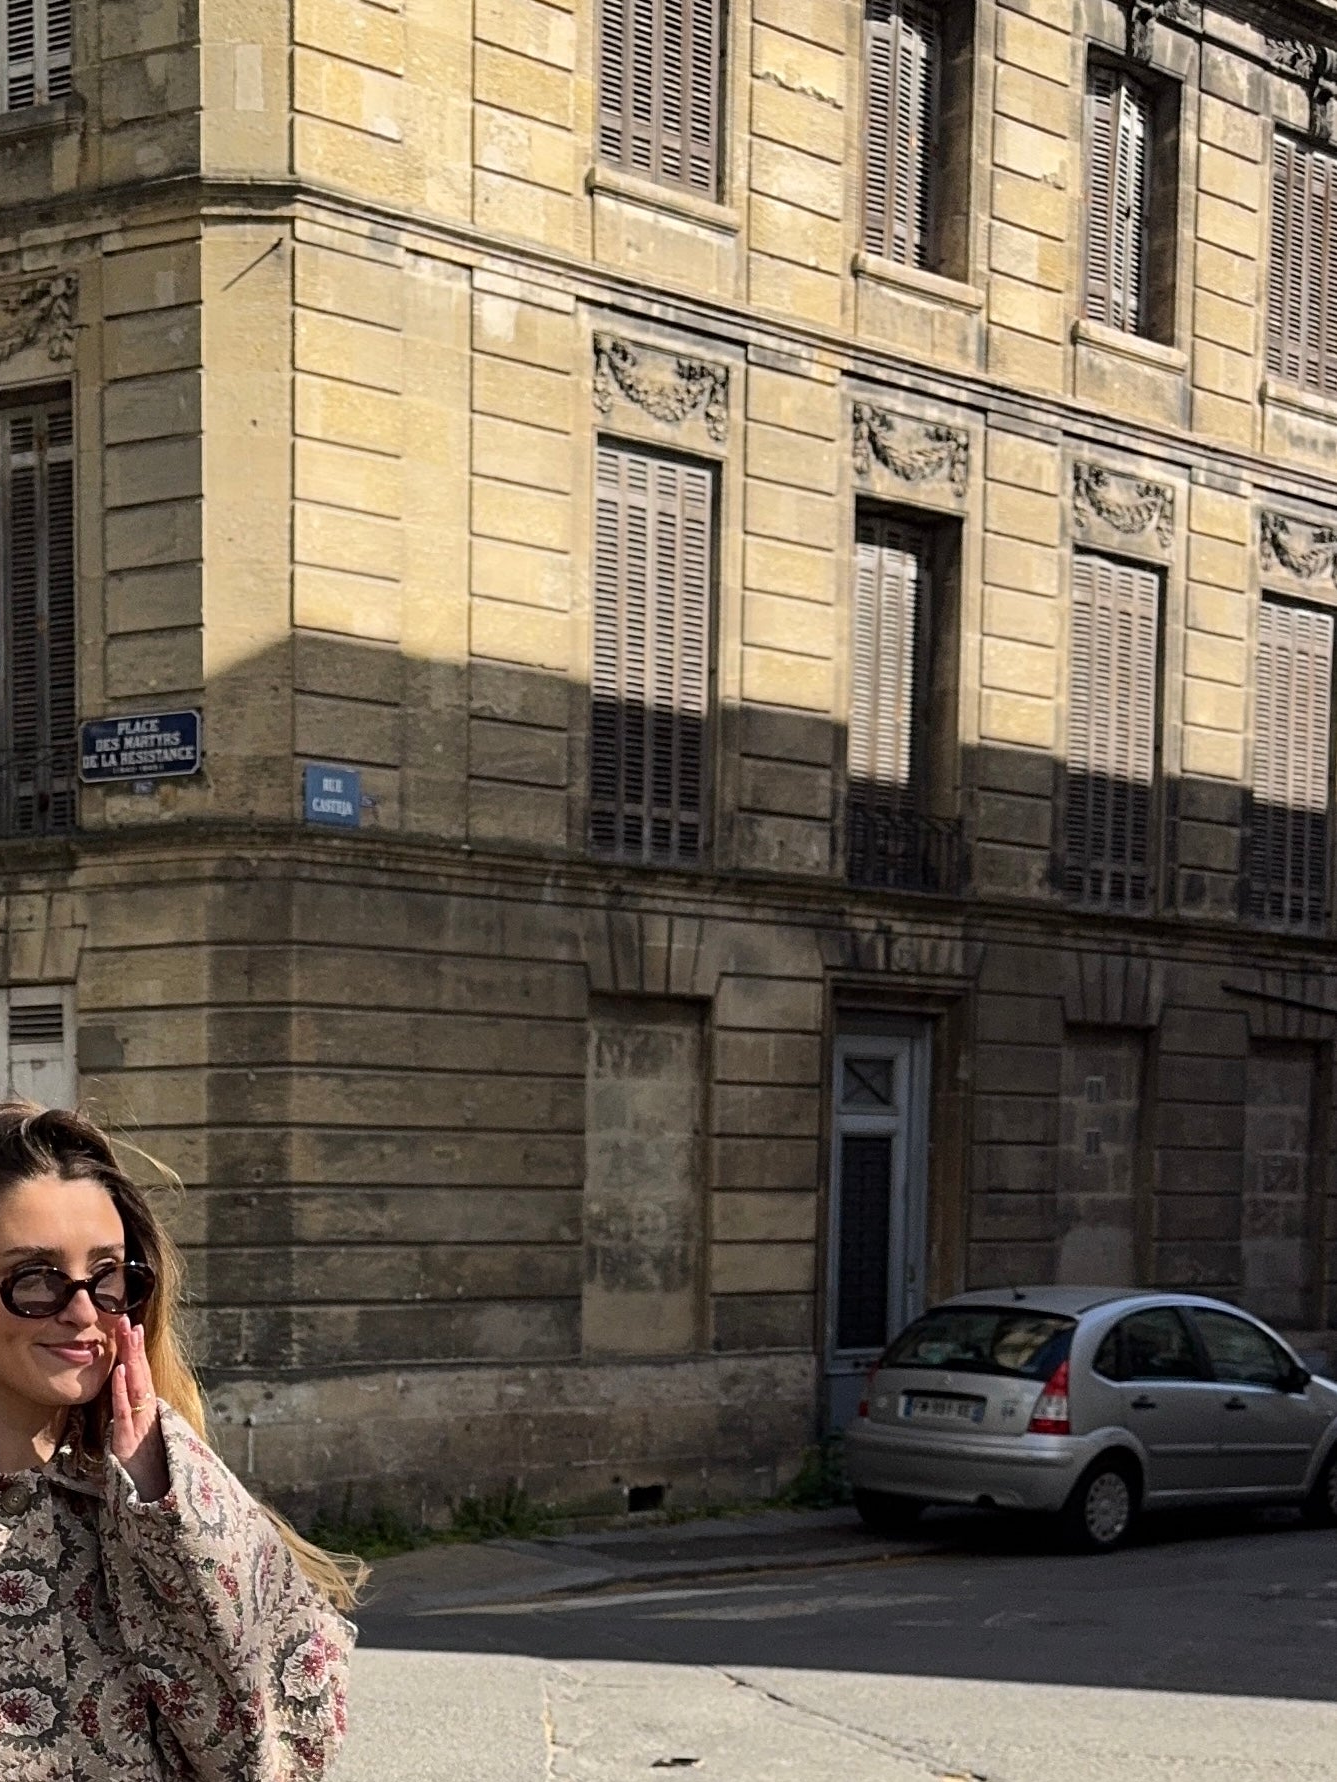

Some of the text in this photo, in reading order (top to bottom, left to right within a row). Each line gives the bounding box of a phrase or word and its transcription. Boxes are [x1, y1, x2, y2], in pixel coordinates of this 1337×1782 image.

[117, 719, 160, 735] PLACE
[95, 731, 181, 752] DES MARTYRS
[82, 755, 99, 769] DE
[101, 753, 118, 767] LA
[323, 778, 343, 793] RUE
